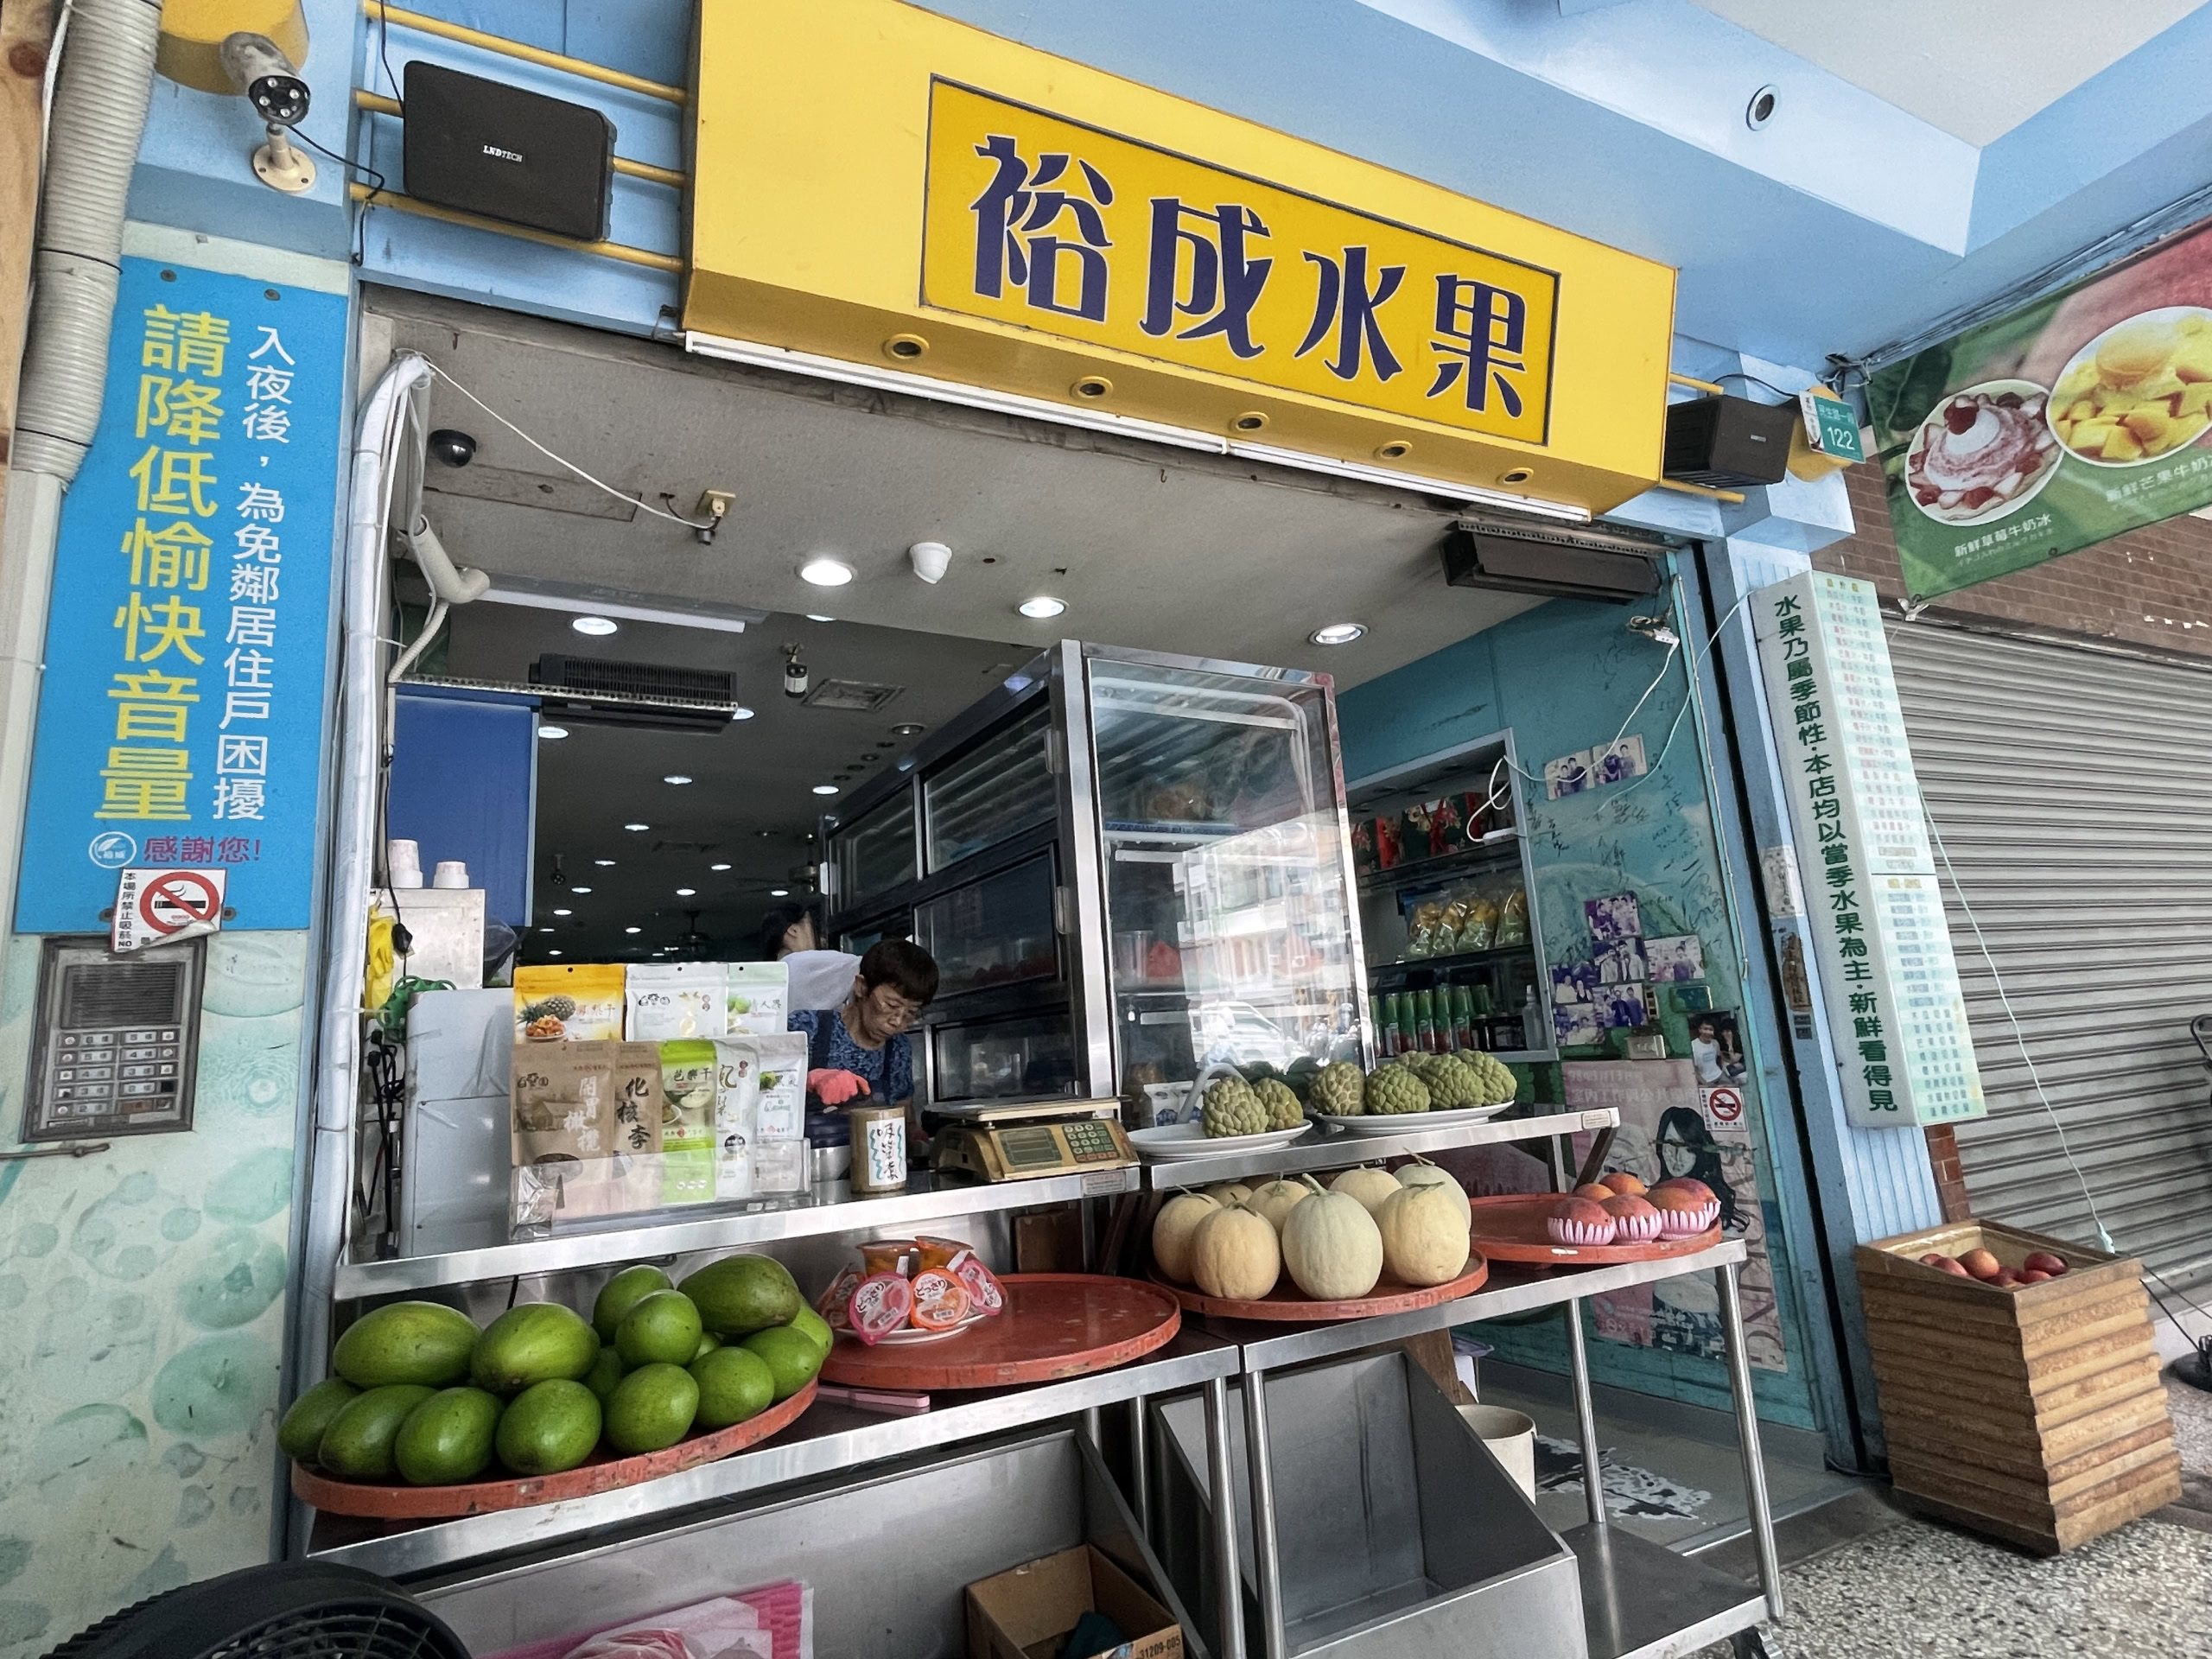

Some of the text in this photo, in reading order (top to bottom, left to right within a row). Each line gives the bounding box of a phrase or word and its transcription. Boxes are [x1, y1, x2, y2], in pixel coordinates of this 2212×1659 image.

[970, 134, 1527, 418] 裕成水果
[1827, 426, 1856, 450] 122
[2106, 454, 2212, 503] 新鮮芒果牛奶
[93, 304, 231, 821] 請降低愉快音量
[143, 836, 261, 863] 感謝您!
[616, 1077, 651, 1149] 化核李
[915, 1279, 947, 1297] どっさり
